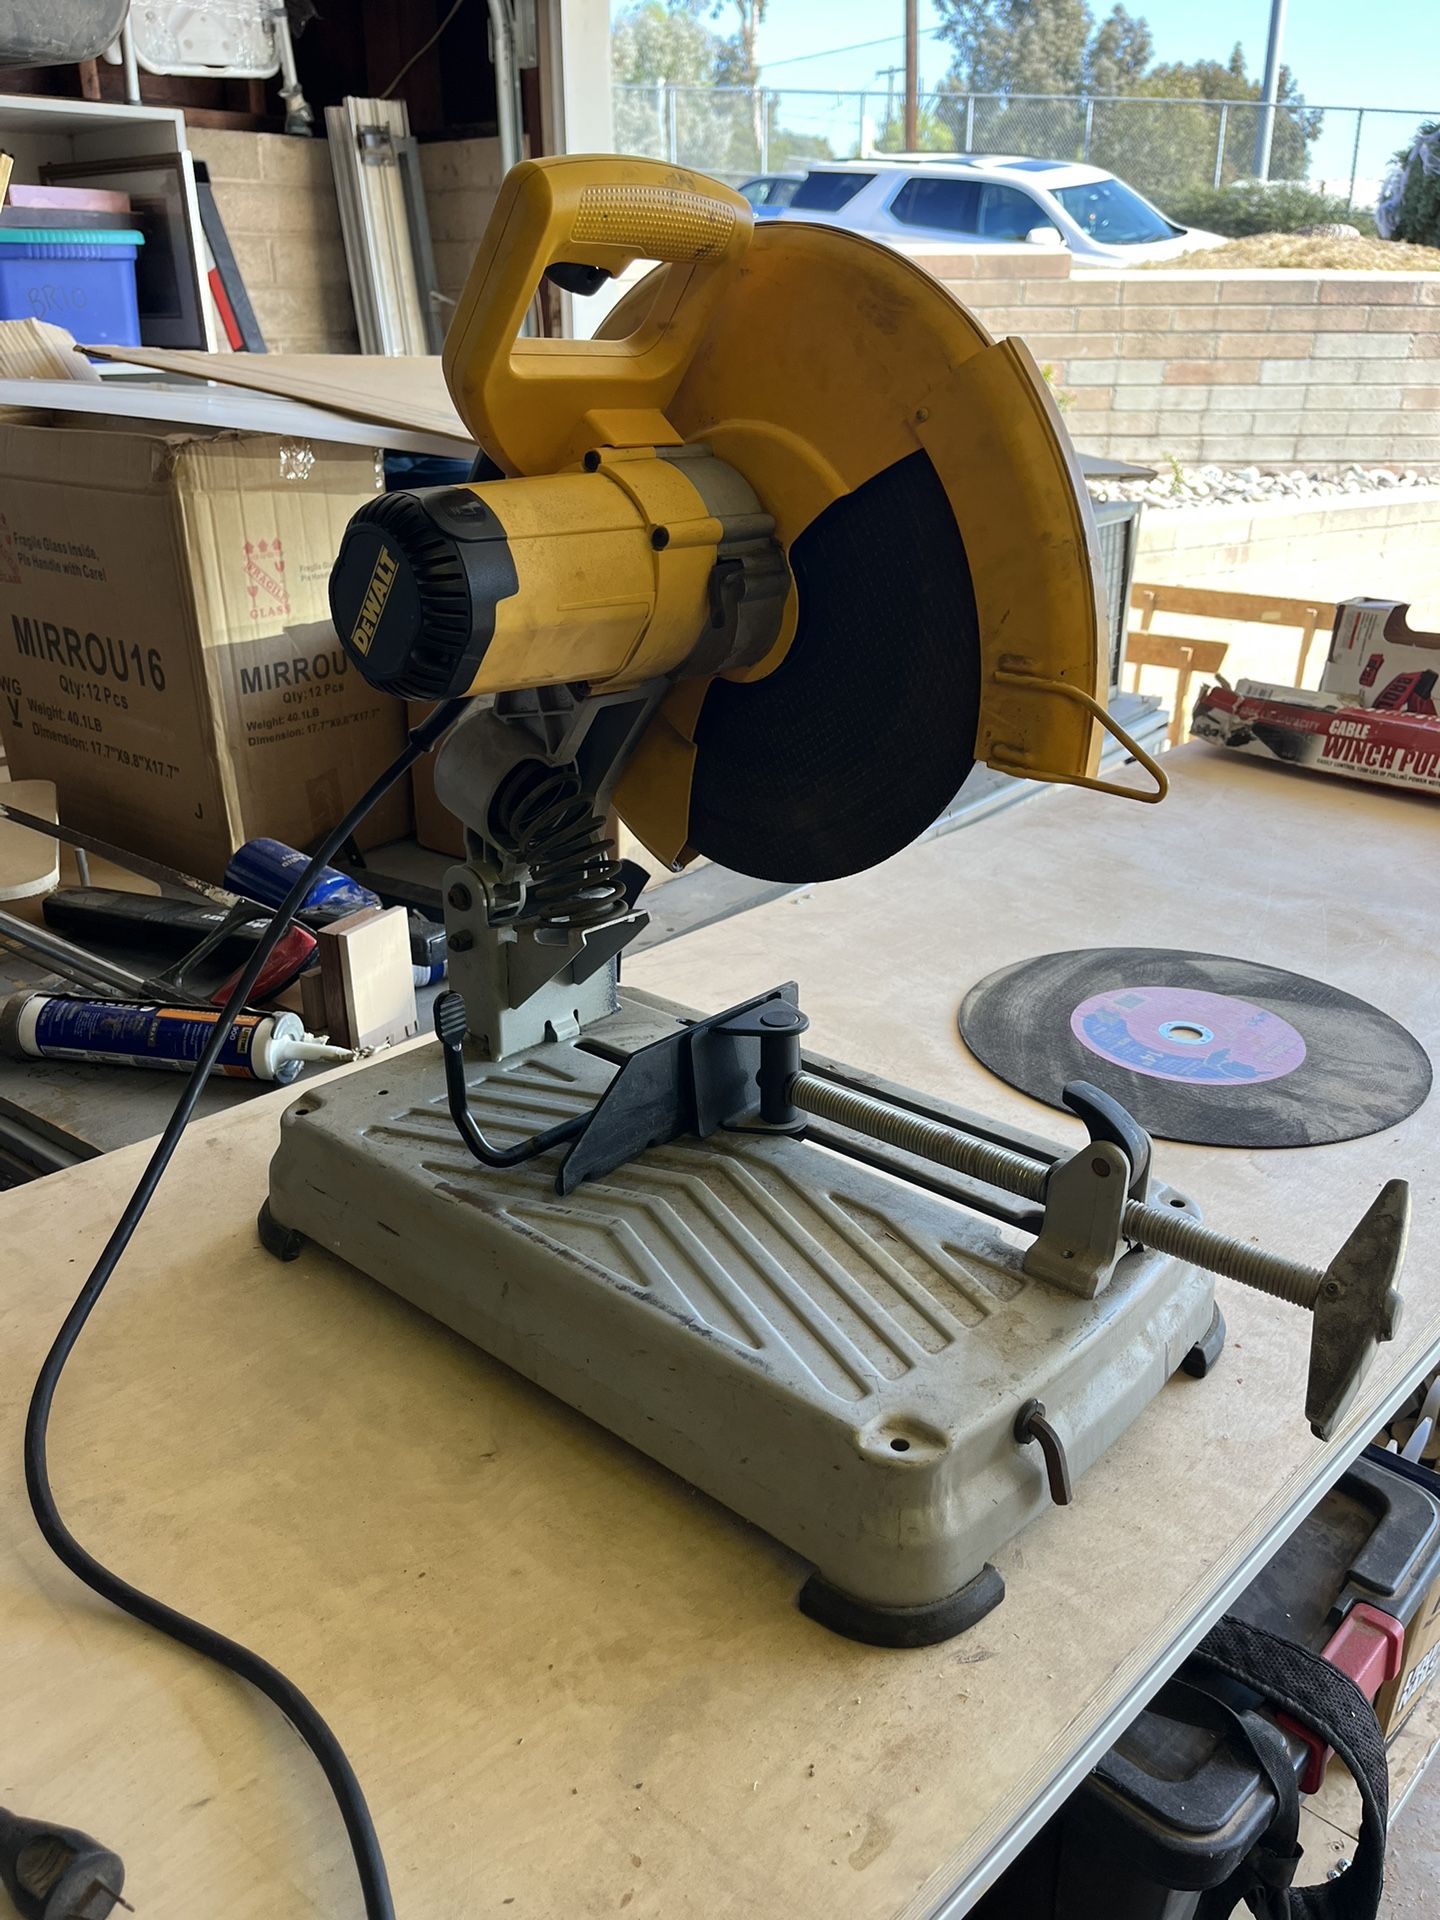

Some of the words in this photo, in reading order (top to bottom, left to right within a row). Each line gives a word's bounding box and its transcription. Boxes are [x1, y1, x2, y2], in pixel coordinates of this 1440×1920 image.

[43, 537, 68, 554] Glass
[32, 556, 61, 573] Handle
[62, 561, 82, 576] with
[352, 545, 397, 655] DEWALT
[11, 614, 166, 692] MIRROU16
[240, 650, 349, 694] MIRROU
[104, 687, 129, 710] Pcs
[324, 683, 345, 694] Pcs
[27, 698, 66, 721] Weight:
[246, 716, 285, 732] Weight:
[1328, 719, 1371, 740] CABLE
[32, 721, 89, 752] Dimension:
[248, 728, 304, 747] Dimension:
[1322, 735, 1396, 769] WINCH
[1398, 748, 1440, 780] PUL
